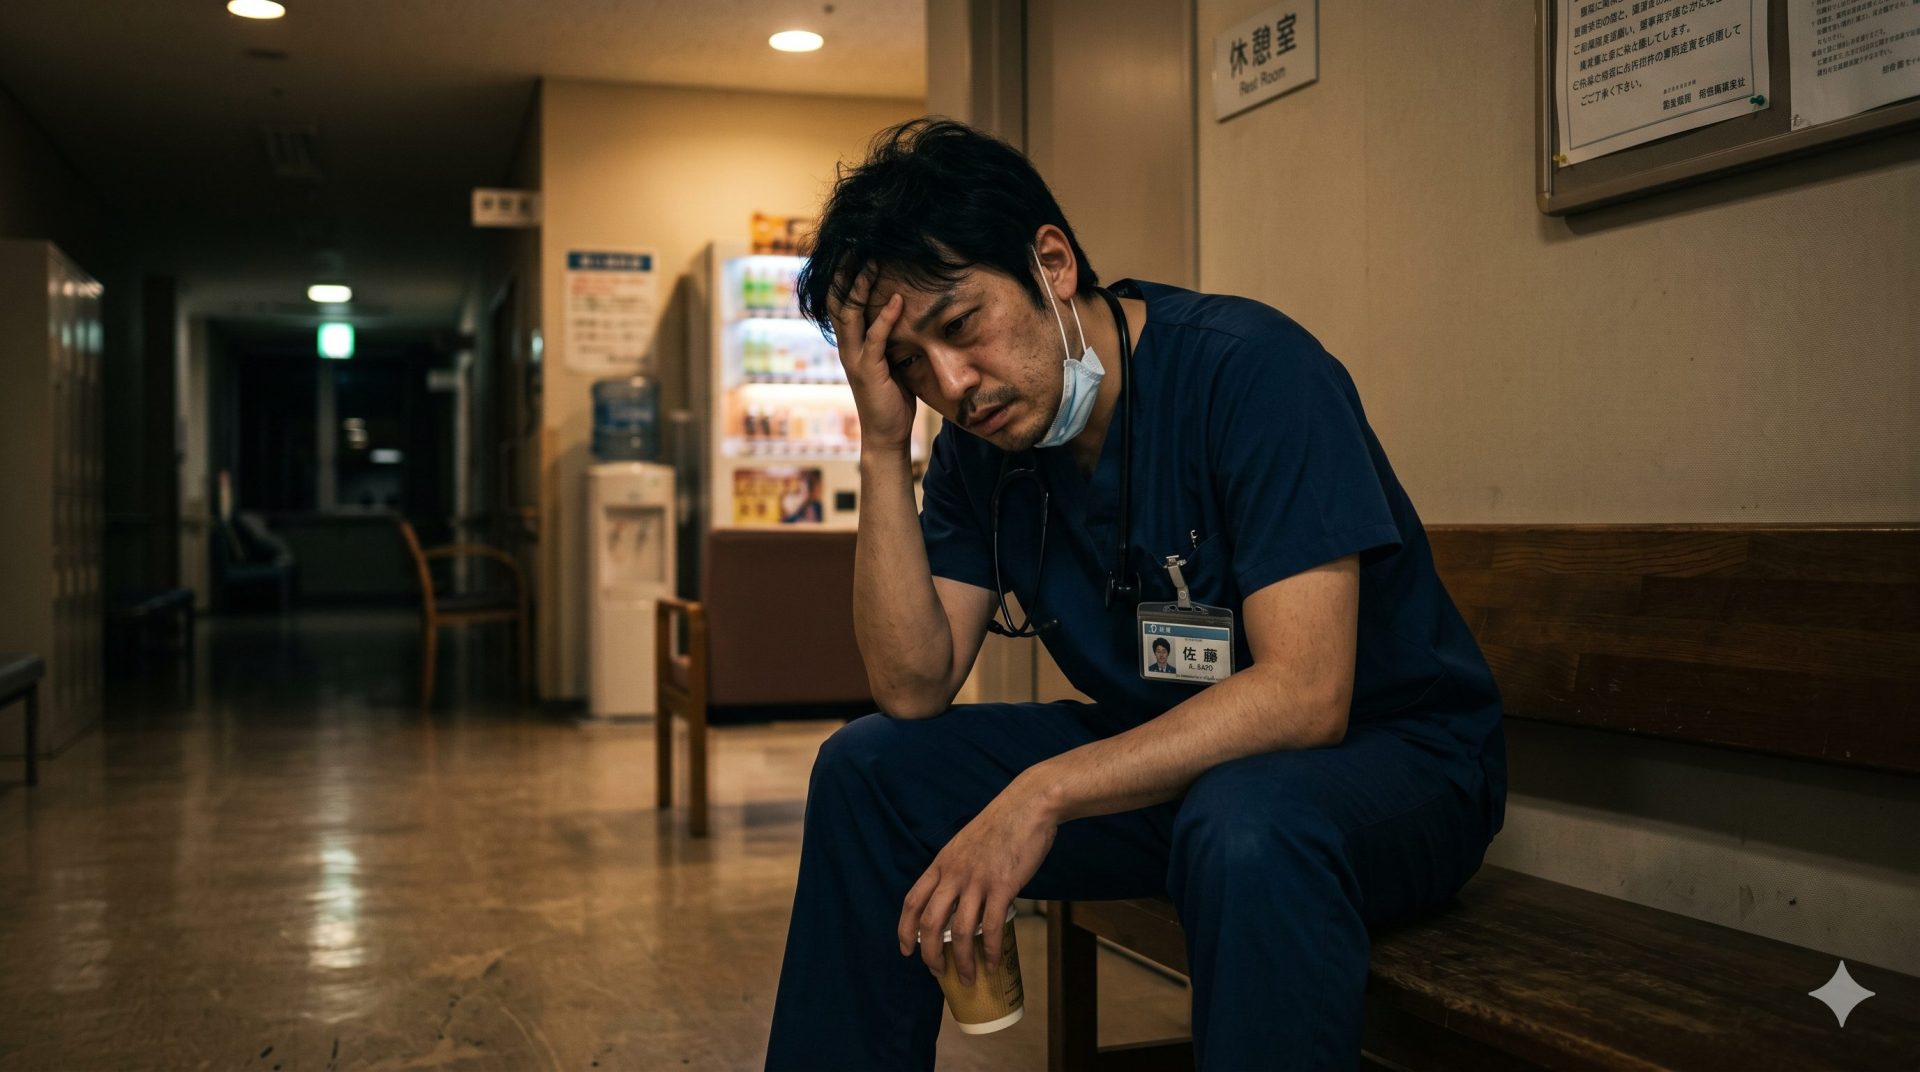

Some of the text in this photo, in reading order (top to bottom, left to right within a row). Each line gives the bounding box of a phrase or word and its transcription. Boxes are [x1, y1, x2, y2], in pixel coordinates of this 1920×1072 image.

[1230, 13, 1297, 79] 休憩室
[1261, 67, 1286, 86] Room
[1182, 646, 1218, 663] 佐藤
